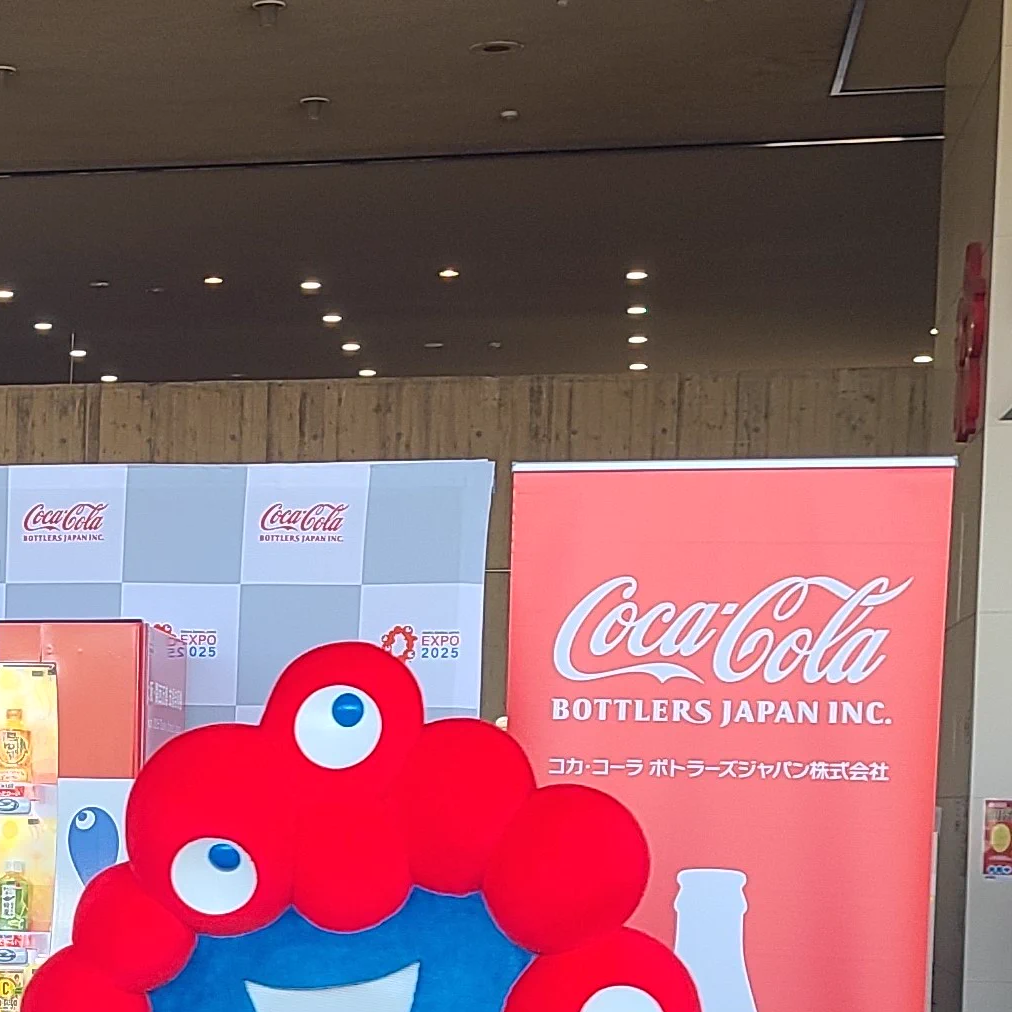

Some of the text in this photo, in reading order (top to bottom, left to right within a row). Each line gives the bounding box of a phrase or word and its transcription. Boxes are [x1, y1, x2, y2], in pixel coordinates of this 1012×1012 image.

[23, 503, 109, 531] Coca-Cola
[260, 503, 349, 531] Coca-Cola
[421, 635, 460, 647] EXPO
[553, 575, 914, 684] Coca-Cola
[189, 646, 216, 657] 025
[421, 647, 459, 659] 2025
[551, 698, 893, 728] BOTTLERS JAPAN INC.
[548, 758, 890, 782] コカ・コーラ ボトラーズジャパン株式会社
